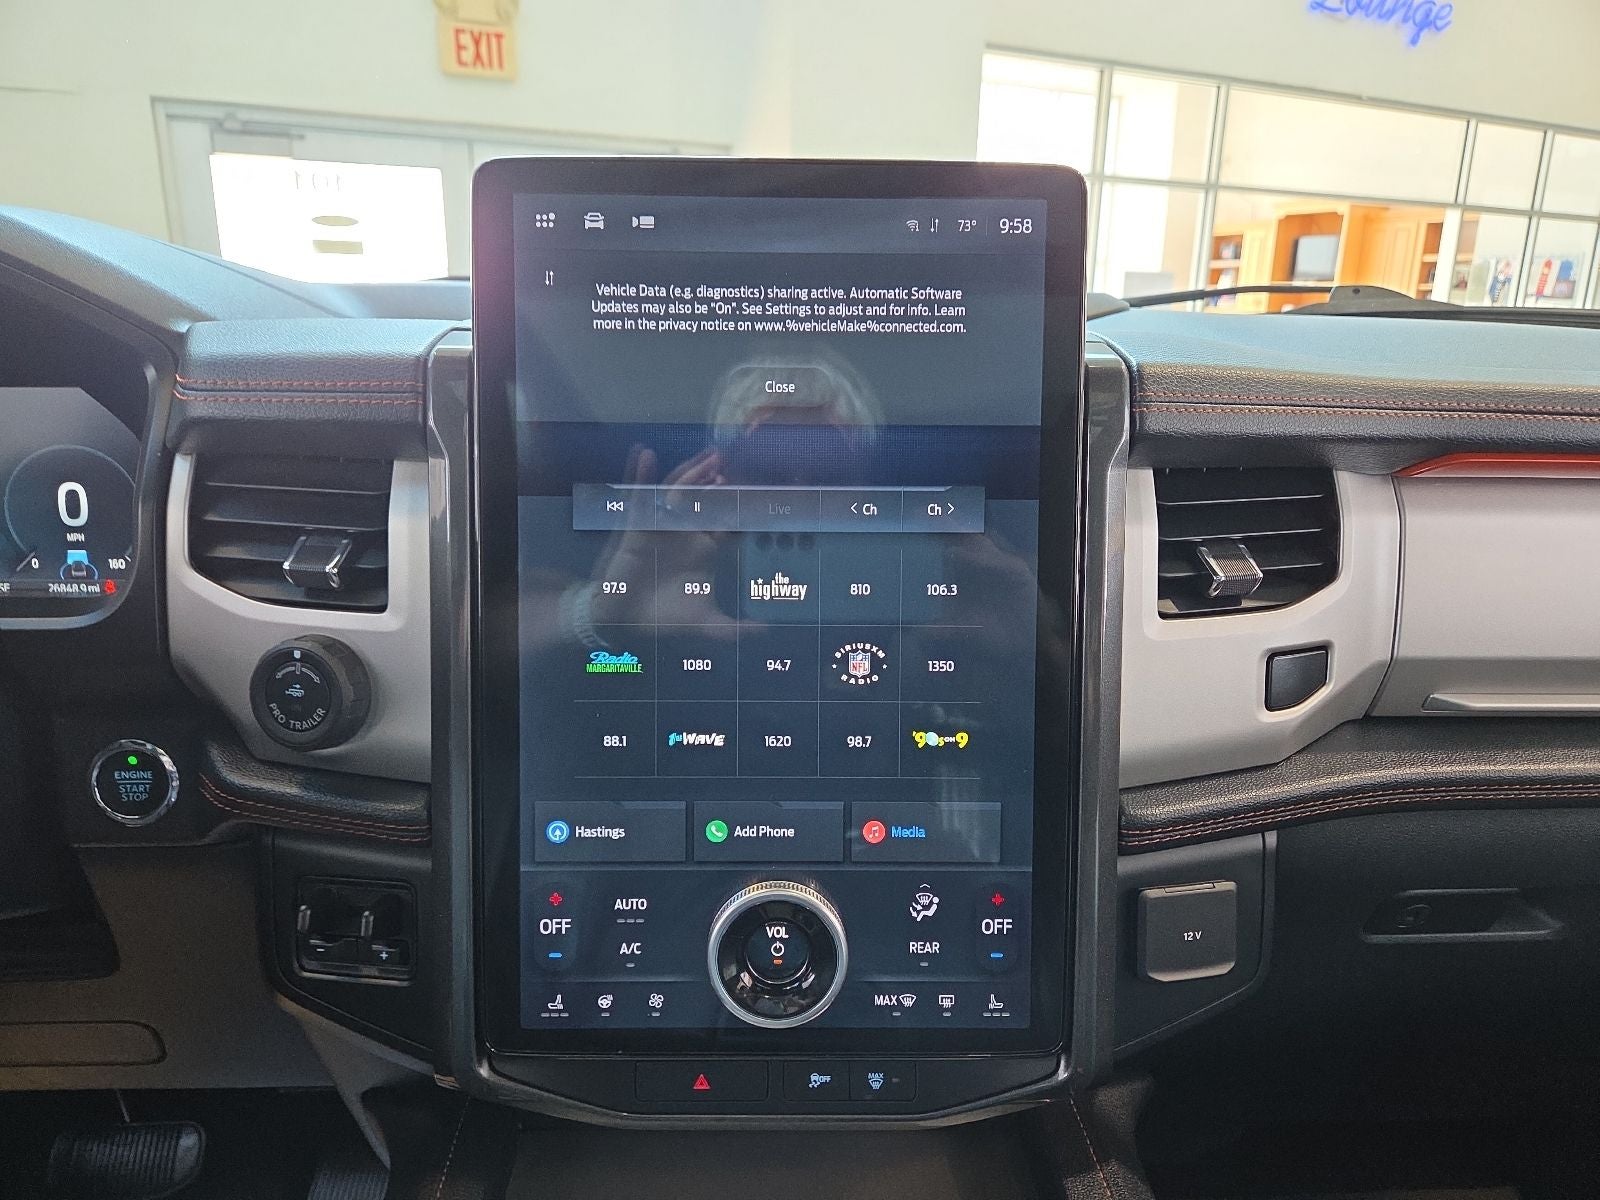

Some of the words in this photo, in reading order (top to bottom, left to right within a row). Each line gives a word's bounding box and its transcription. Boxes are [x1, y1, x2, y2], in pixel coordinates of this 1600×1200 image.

[1310, 0, 1453, 46] ounge
[454, 28, 505, 72] EXIT
[999, 217, 1033, 234] 9:58
[595, 283, 637, 297] Vehicle
[639, 284, 667, 297] Data
[669, 284, 694, 300] (e.g.
[696, 284, 765, 300] diagnostics)
[767, 285, 808, 300] sharing
[810, 286, 847, 299] active.
[849, 286, 909, 299] Automatic
[911, 286, 963, 300] Software
[591, 300, 639, 314] Updates
[641, 302, 666, 315] may
[668, 301, 692, 314] also
[694, 301, 709, 314] be
[741, 302, 763, 315] See
[765, 302, 812, 317] Settings
[813, 304, 826, 315] to
[828, 303, 863, 318] adjust
[865, 303, 887, 316] and
[889, 303, 905, 316] for
[907, 303, 932, 316] info.
[934, 303, 966, 317] Learn
[593, 318, 622, 330] more
[624, 317, 636, 330] in
[637, 317, 657, 330] the
[658, 317, 698, 332] privacy
[700, 318, 736, 331] notice
[737, 319, 752, 331] on
[753, 318, 967, 333] www.%vehicleMake%connected.com.
[765, 381, 796, 393] Close
[57, 481, 89, 527] 0
[768, 503, 791, 515] Live
[862, 503, 878, 516] Ch
[927, 503, 943, 516] Ch
[31, 557, 40, 569] 0
[775, 571, 790, 584] the
[602, 582, 628, 594] 97.9
[684, 582, 711, 595] 89.9
[750, 577, 808, 601] highway
[850, 583, 871, 596] 810
[926, 584, 958, 596] 106.3
[834, 642, 886, 660] SIRIUSXM
[589, 651, 641, 664] Radio
[586, 663, 642, 674] MARGARITAVILLE
[682, 659, 712, 671] 1080
[766, 660, 792, 671] 94.7
[851, 663, 868, 673] NFL
[928, 661, 955, 672] 1350
[840, 674, 879, 685] RADIO
[269, 703, 286, 723] PRO
[289, 707, 326, 730] TRAILER
[603, 736, 627, 748] 88.1
[764, 736, 792, 748] 1620
[847, 736, 872, 748] 98.7
[956, 732, 969, 749] 9
[114, 770, 153, 779] ENGINE
[119, 784, 150, 793] START
[121, 793, 149, 802] STOP
[575, 826, 626, 840] Hastings
[734, 826, 757, 838] Add
[759, 826, 795, 838] Phone
[891, 826, 926, 838] Media
[614, 898, 647, 910] AUTO
[539, 918, 572, 935] OFF
[765, 926, 789, 939] VOL
[981, 918, 1013, 935] OFF
[1183, 931, 1194, 941] 12
[1195, 930, 1202, 940] V
[619, 942, 642, 955] A/C
[909, 941, 940, 954] REAR
[874, 994, 898, 1006] MAX
[819, 1075, 832, 1083] OFF
